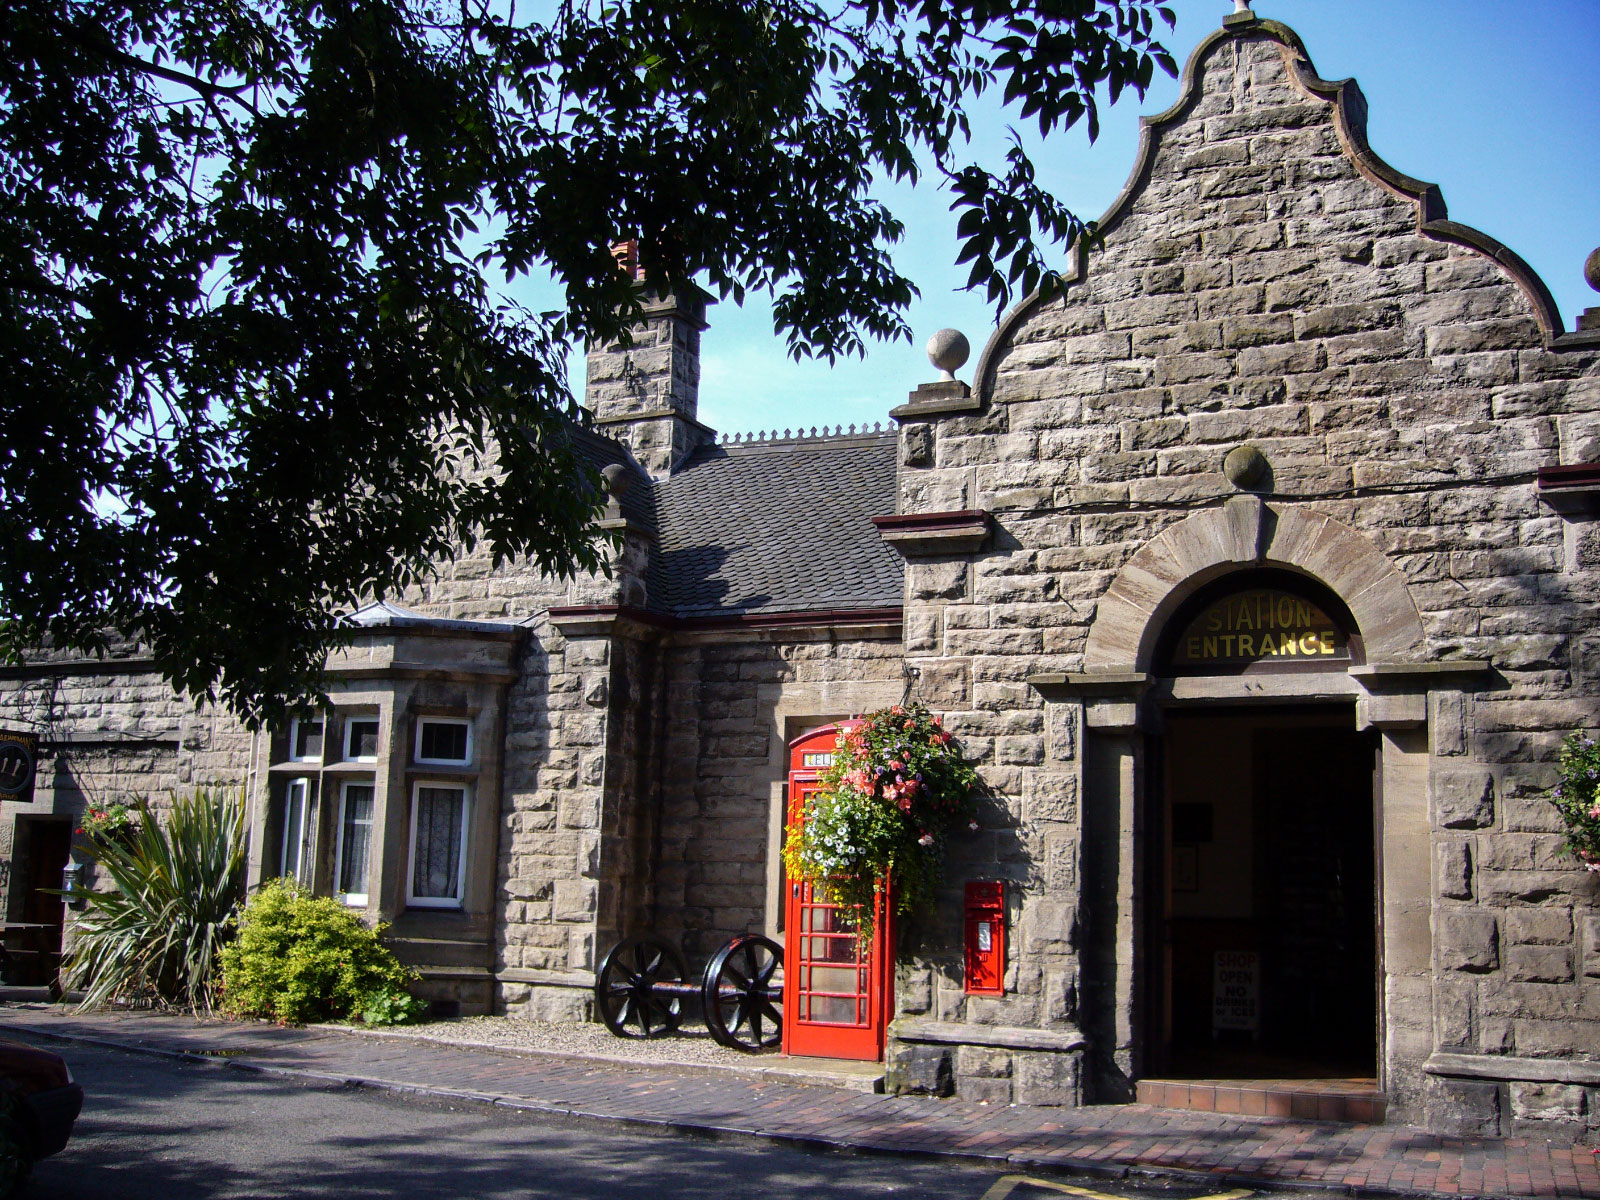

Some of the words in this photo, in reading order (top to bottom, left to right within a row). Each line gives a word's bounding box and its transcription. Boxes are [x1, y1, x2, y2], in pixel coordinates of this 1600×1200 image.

[1207, 593, 1311, 632] STATION
[1187, 631, 1335, 659] ENTRANCE
[1217, 952, 1256, 968] SHOP
[1220, 970, 1253, 984] OPEN
[1225, 986, 1247, 997] NO
[1216, 997, 1256, 1007] DRINKS
[1231, 1007, 1256, 1017] ICES
